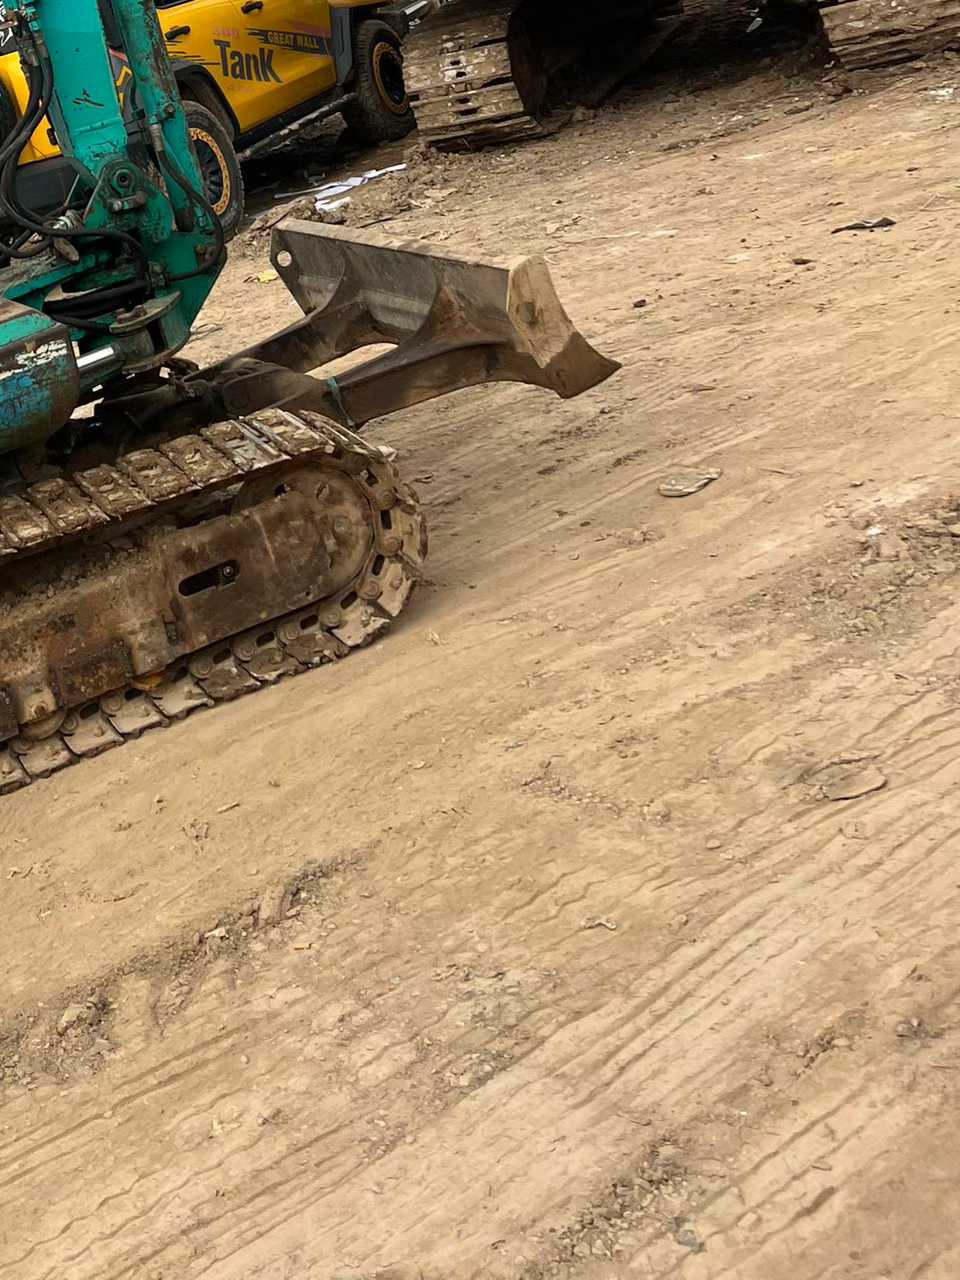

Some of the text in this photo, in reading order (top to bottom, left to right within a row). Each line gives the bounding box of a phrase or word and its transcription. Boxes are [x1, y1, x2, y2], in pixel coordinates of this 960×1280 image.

[267, 31, 321, 50] GREAT WALL
[213, 38, 284, 84] Tank
